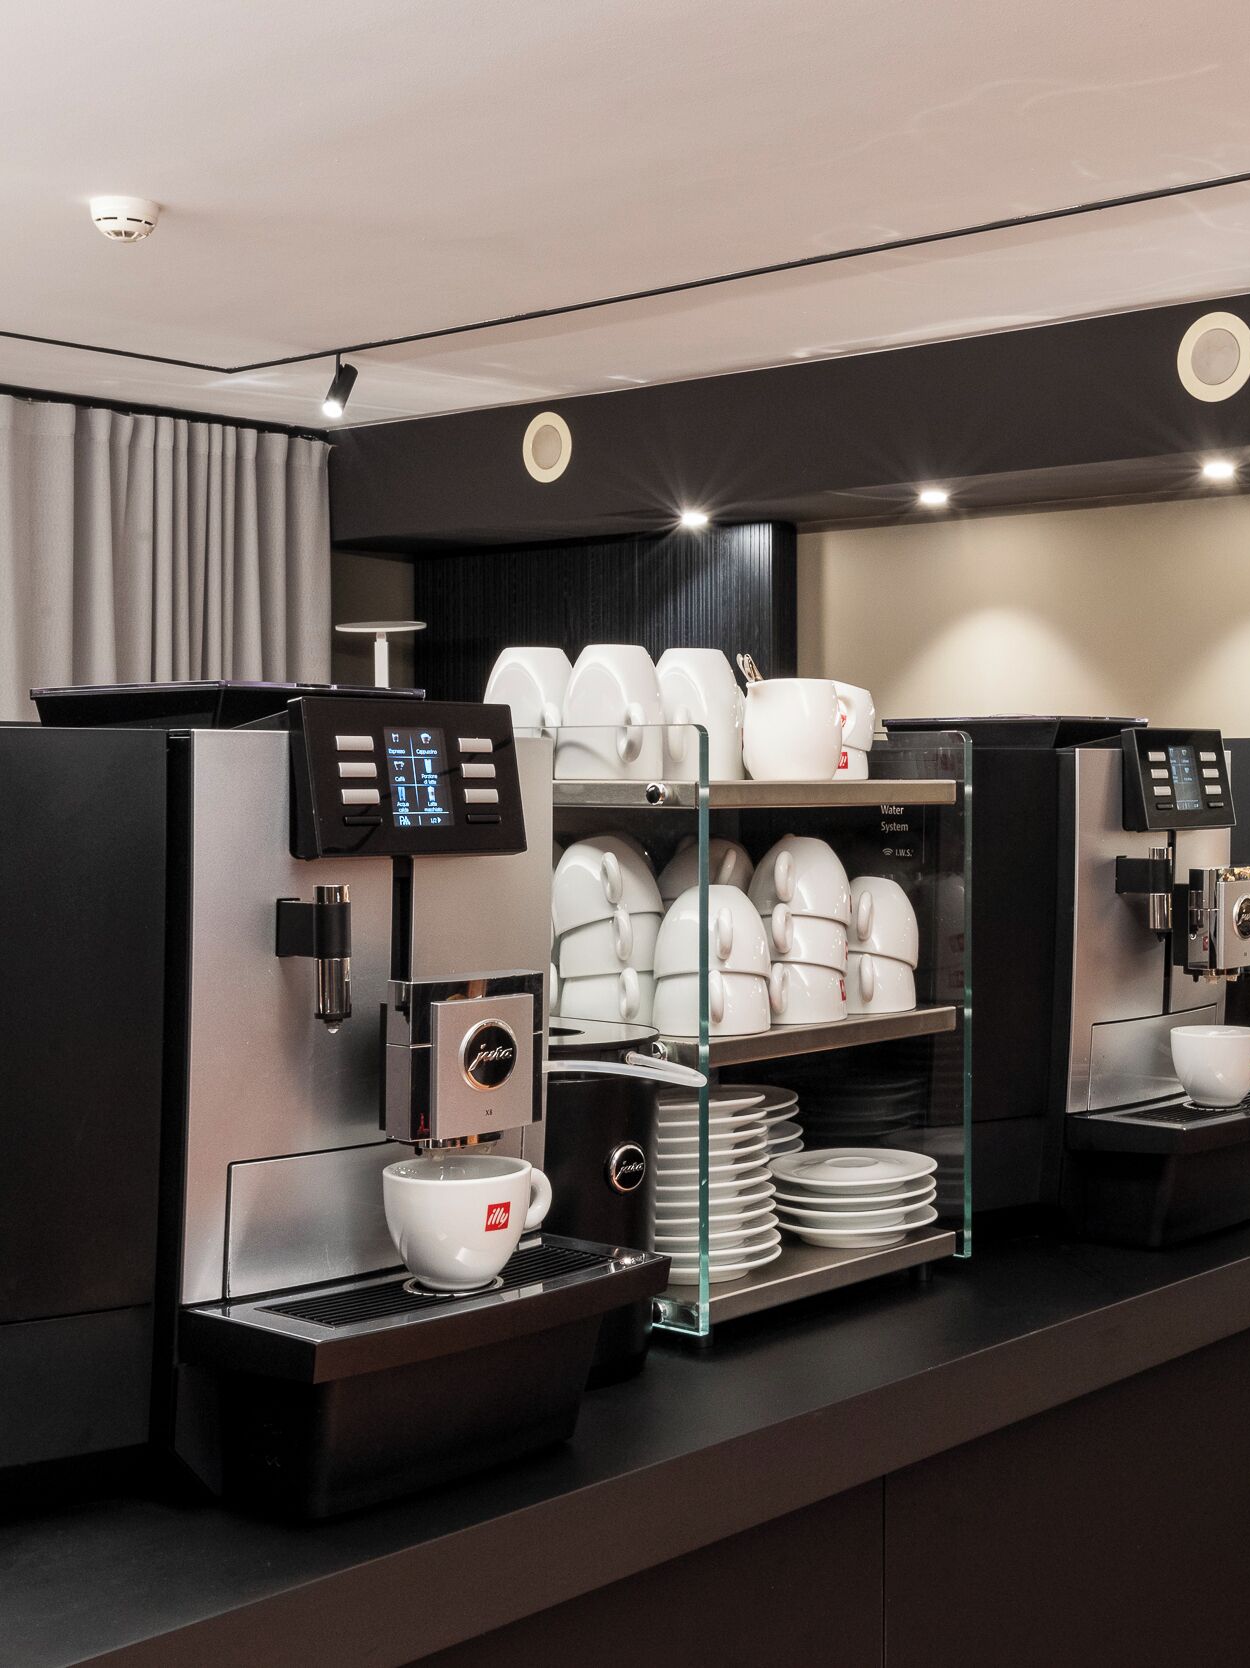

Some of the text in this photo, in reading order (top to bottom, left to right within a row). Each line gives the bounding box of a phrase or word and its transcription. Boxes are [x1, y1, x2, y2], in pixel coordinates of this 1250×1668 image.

[880, 804, 905, 815] Water
[880, 821, 909, 834] System
[468, 1043, 513, 1073] jura
[615, 1160, 644, 1180] jura
[487, 1207, 509, 1228] illy
